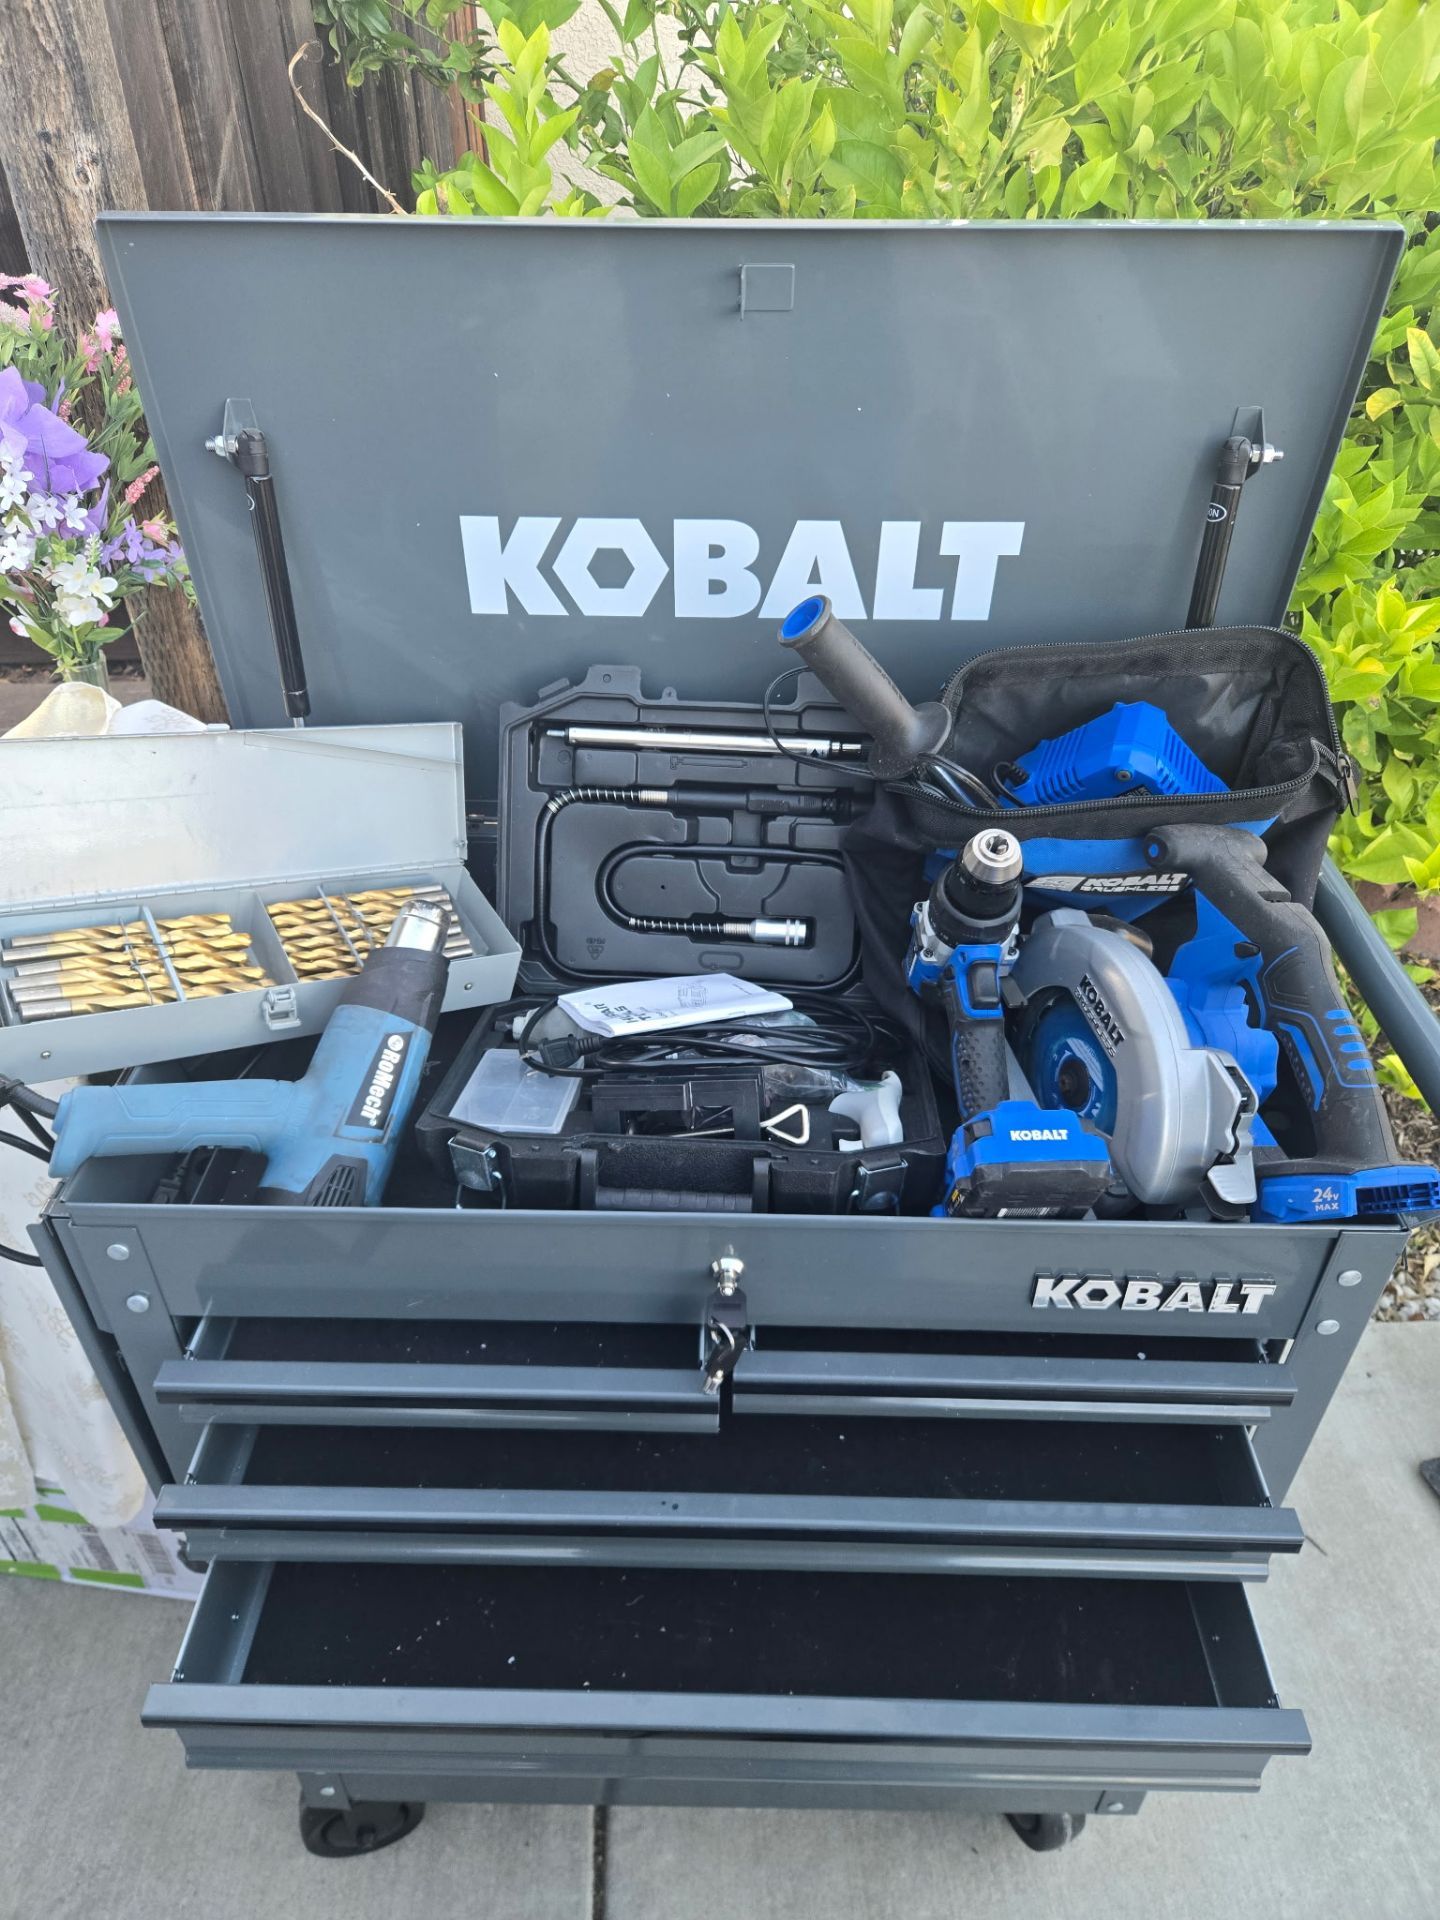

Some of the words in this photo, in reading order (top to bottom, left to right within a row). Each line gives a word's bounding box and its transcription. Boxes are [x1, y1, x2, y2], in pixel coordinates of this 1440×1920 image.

[459, 515, 1025, 621] KOBALT
[1080, 885, 1180, 893] BRUSHLESS
[1084, 873, 1189, 887] KOBALT
[1079, 974, 1126, 1046] KOBALT
[360, 1048, 401, 1121] RoMech
[1009, 1129, 1069, 1141] KOBALT
[1315, 1202, 1340, 1212] MAX
[1031, 1277, 1277, 1315] KOBALT
